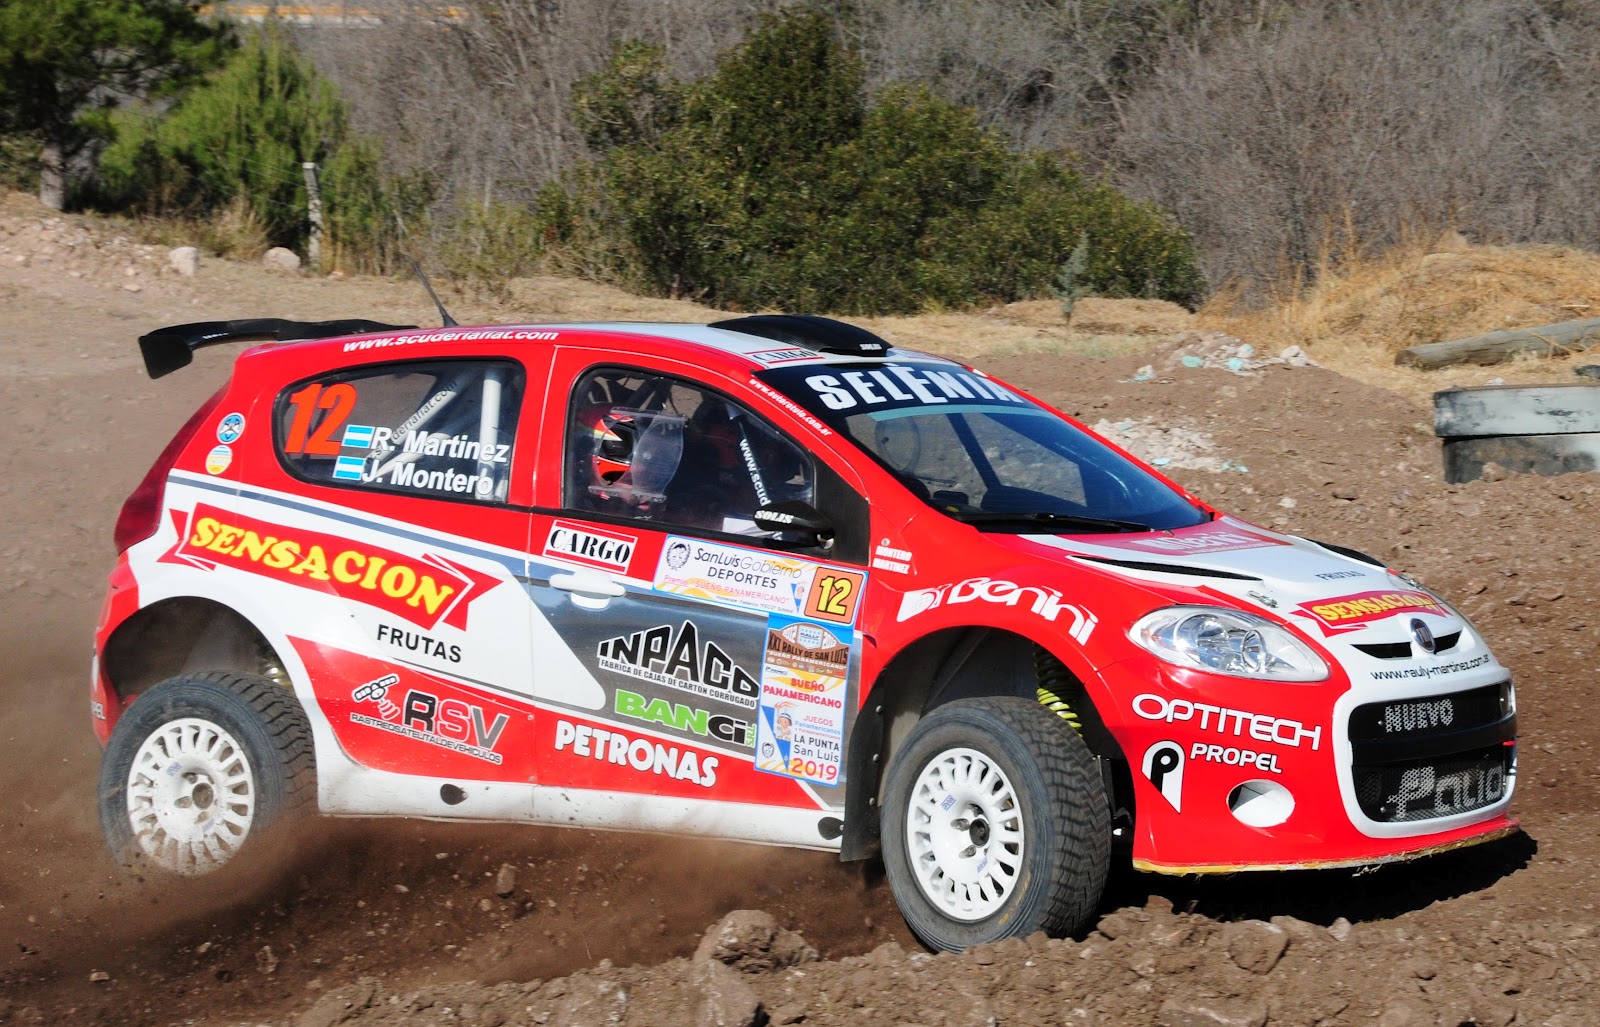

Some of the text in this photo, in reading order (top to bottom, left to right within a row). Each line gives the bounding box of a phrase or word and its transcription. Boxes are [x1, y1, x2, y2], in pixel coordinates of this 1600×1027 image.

[343, 330, 559, 352] www.scuderiafiat.com
[284, 383, 358, 456] 12
[371, 427, 510, 463] R. Martinez
[361, 459, 494, 496] J. Montero
[754, 510, 794, 524] SOLIS
[550, 529, 631, 564] CARGO
[190, 517, 455, 616] SENSACION
[708, 566, 778, 589] DEPORTES
[816, 575, 852, 616] 12
[947, 577, 1099, 646] Benini
[1312, 593, 1438, 621] SENSACION
[376, 624, 462, 663] FRUTAS
[782, 640, 804, 656] RALLY
[805, 649, 813, 659] DE
[815, 651, 830, 661] SAN
[1371, 653, 1490, 680] www.rauly-martinez.com.ar
[600, 660, 755, 708] FABRICA DE CAJAS DE CARTON CORRUGADO
[763, 684, 842, 709] PANAMERICANO
[402, 689, 510, 750] RSV
[803, 714, 834, 727] JUEGOS
[1131, 693, 1322, 751] OPTITECH
[1385, 699, 1454, 732] NUEVO
[555, 720, 719, 788] PETRONAS
[793, 744, 839, 763] San Luis
[794, 734, 840, 752] LA PUNTA
[1190, 742, 1282, 774] PROPEL
[791, 757, 837, 781] 2019
